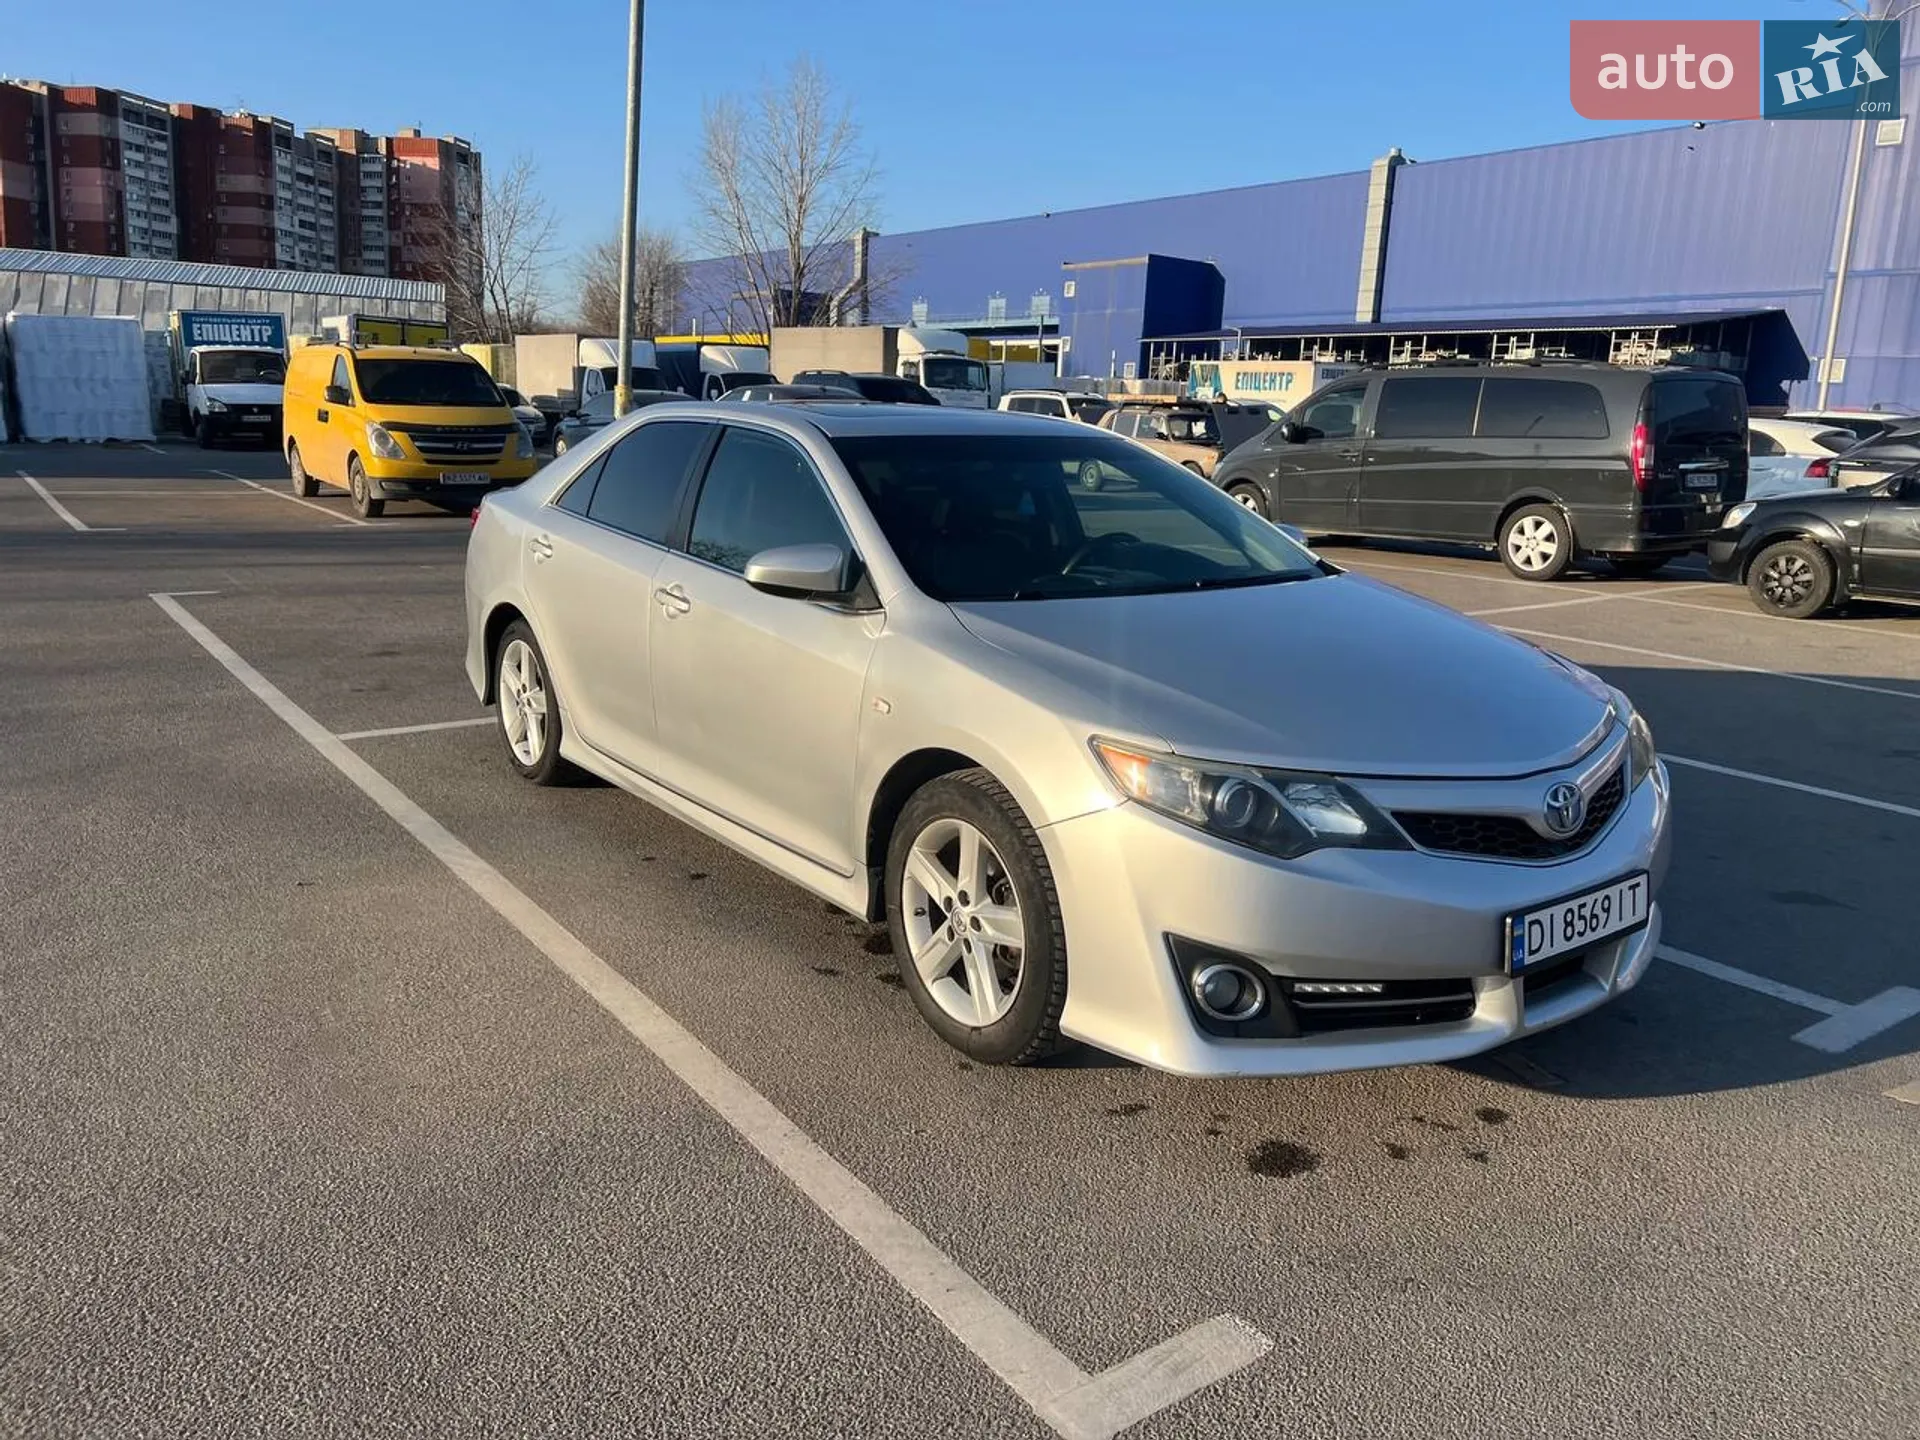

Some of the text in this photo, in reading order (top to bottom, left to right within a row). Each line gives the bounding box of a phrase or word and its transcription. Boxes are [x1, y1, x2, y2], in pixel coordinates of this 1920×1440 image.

[192, 323, 272, 343] ЕПІЦЕНТР
[1235, 371, 1294, 393] ЕПІЦЕНТР
[1528, 882, 1641, 957] DI 8569 IT
